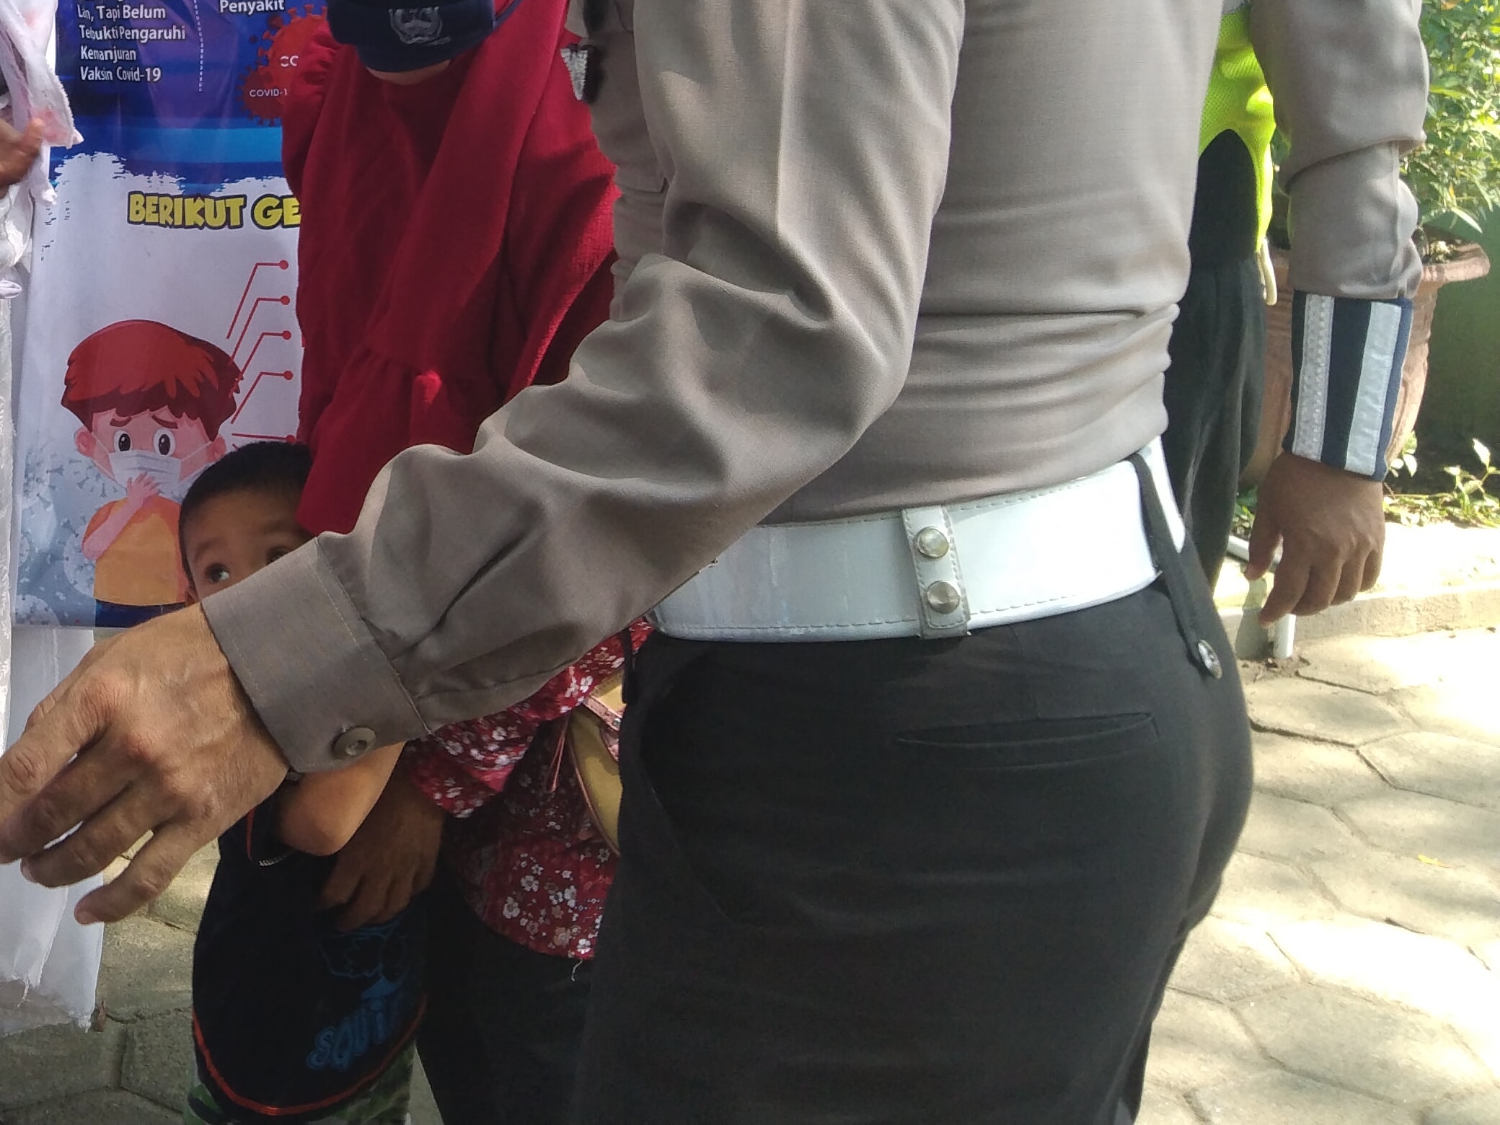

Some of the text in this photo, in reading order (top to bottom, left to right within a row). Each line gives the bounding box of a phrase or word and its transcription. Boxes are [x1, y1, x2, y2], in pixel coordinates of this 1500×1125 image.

[96, 5, 120, 22] Tapi
[123, 3, 165, 19] Belum
[119, 25, 185, 44] Pengaruhi
[80, 65, 161, 82] Vaksin Covid-19
[249, 88, 288, 98] COVID-1
[127, 191, 300, 230] BERIKUT GE
